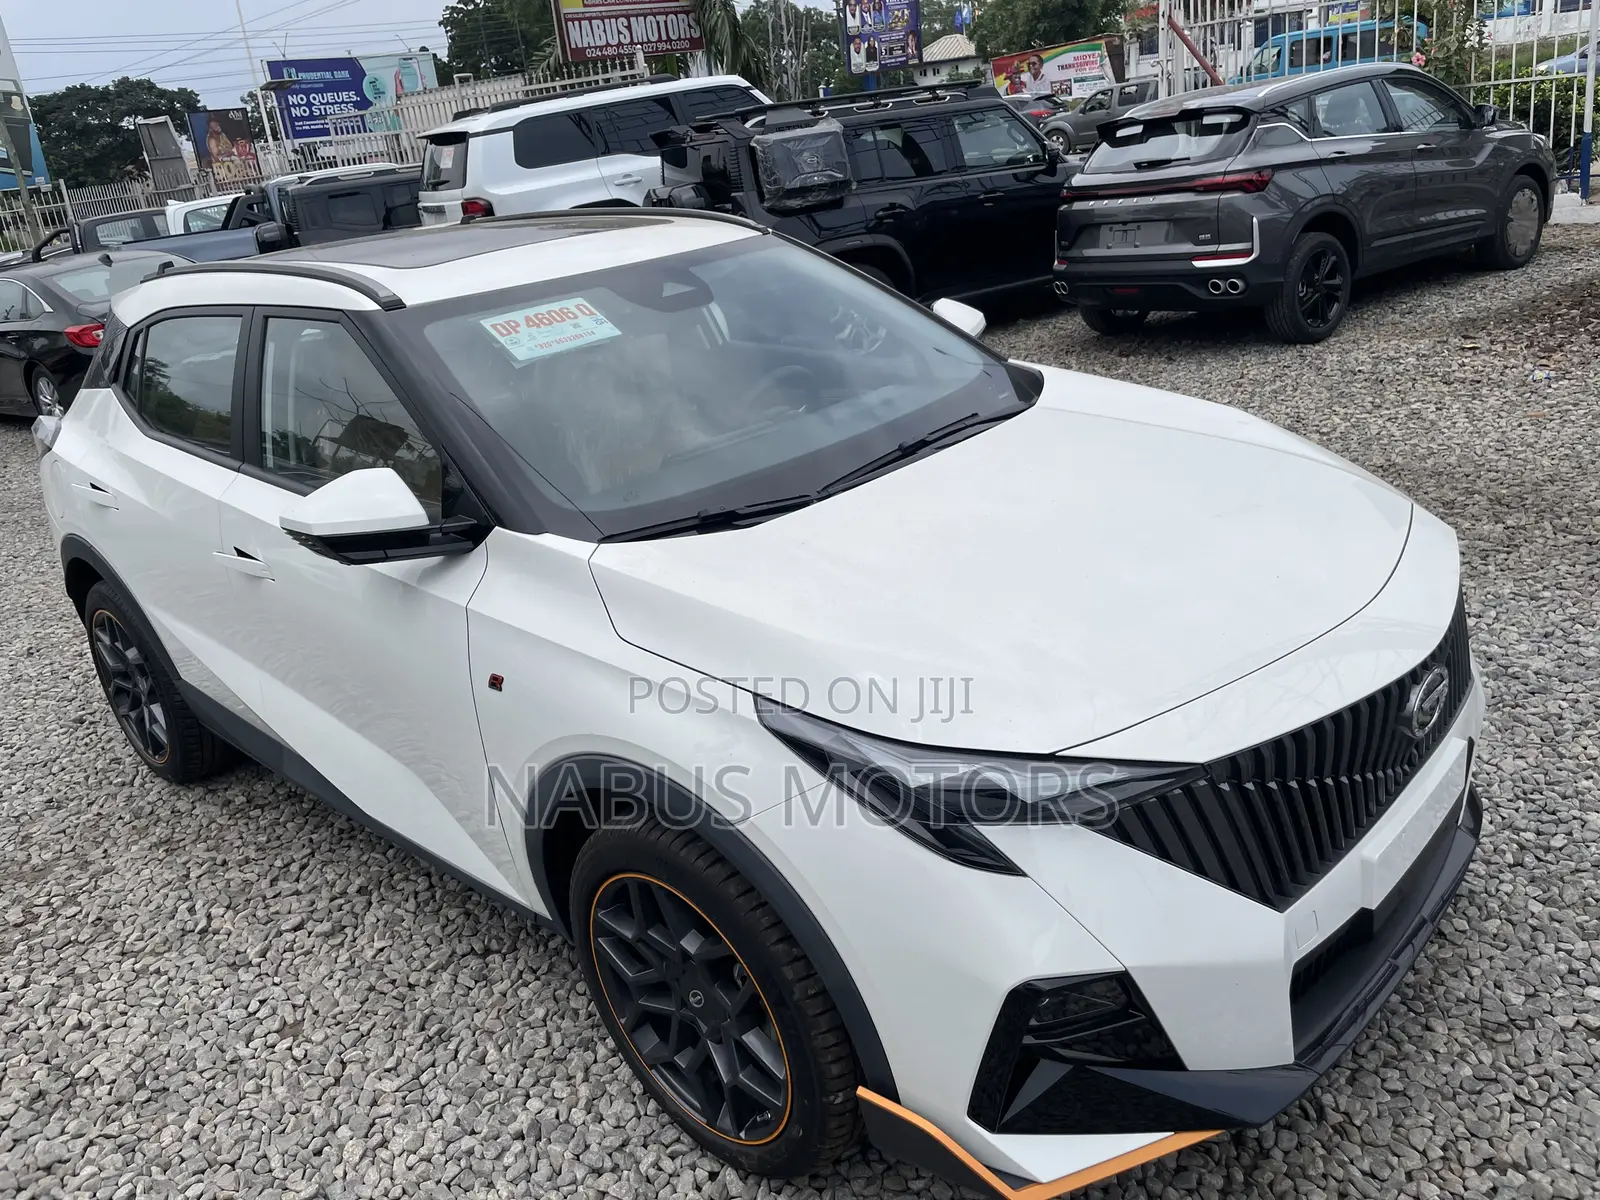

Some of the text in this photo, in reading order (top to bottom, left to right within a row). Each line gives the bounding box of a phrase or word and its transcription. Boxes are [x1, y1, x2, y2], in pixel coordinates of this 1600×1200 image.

[567, 12, 701, 49] NABUS MOTORS
[585, 48, 602, 58] 024
[602, 46, 618, 56] 480
[643, 43, 657, 52] 027
[656, 41, 672, 51] 994
[671, 40, 690, 49] 0200
[1057, 60, 1099, 71] THANKSGIVING
[298, 70, 350, 80] PRUDENTIAL BANK
[287, 94, 307, 105] NO
[309, 91, 360, 105] QUEUES.
[290, 103, 358, 117] NO STRESS.
[489, 319, 521, 337] DP
[523, 306, 580, 329] 4606
